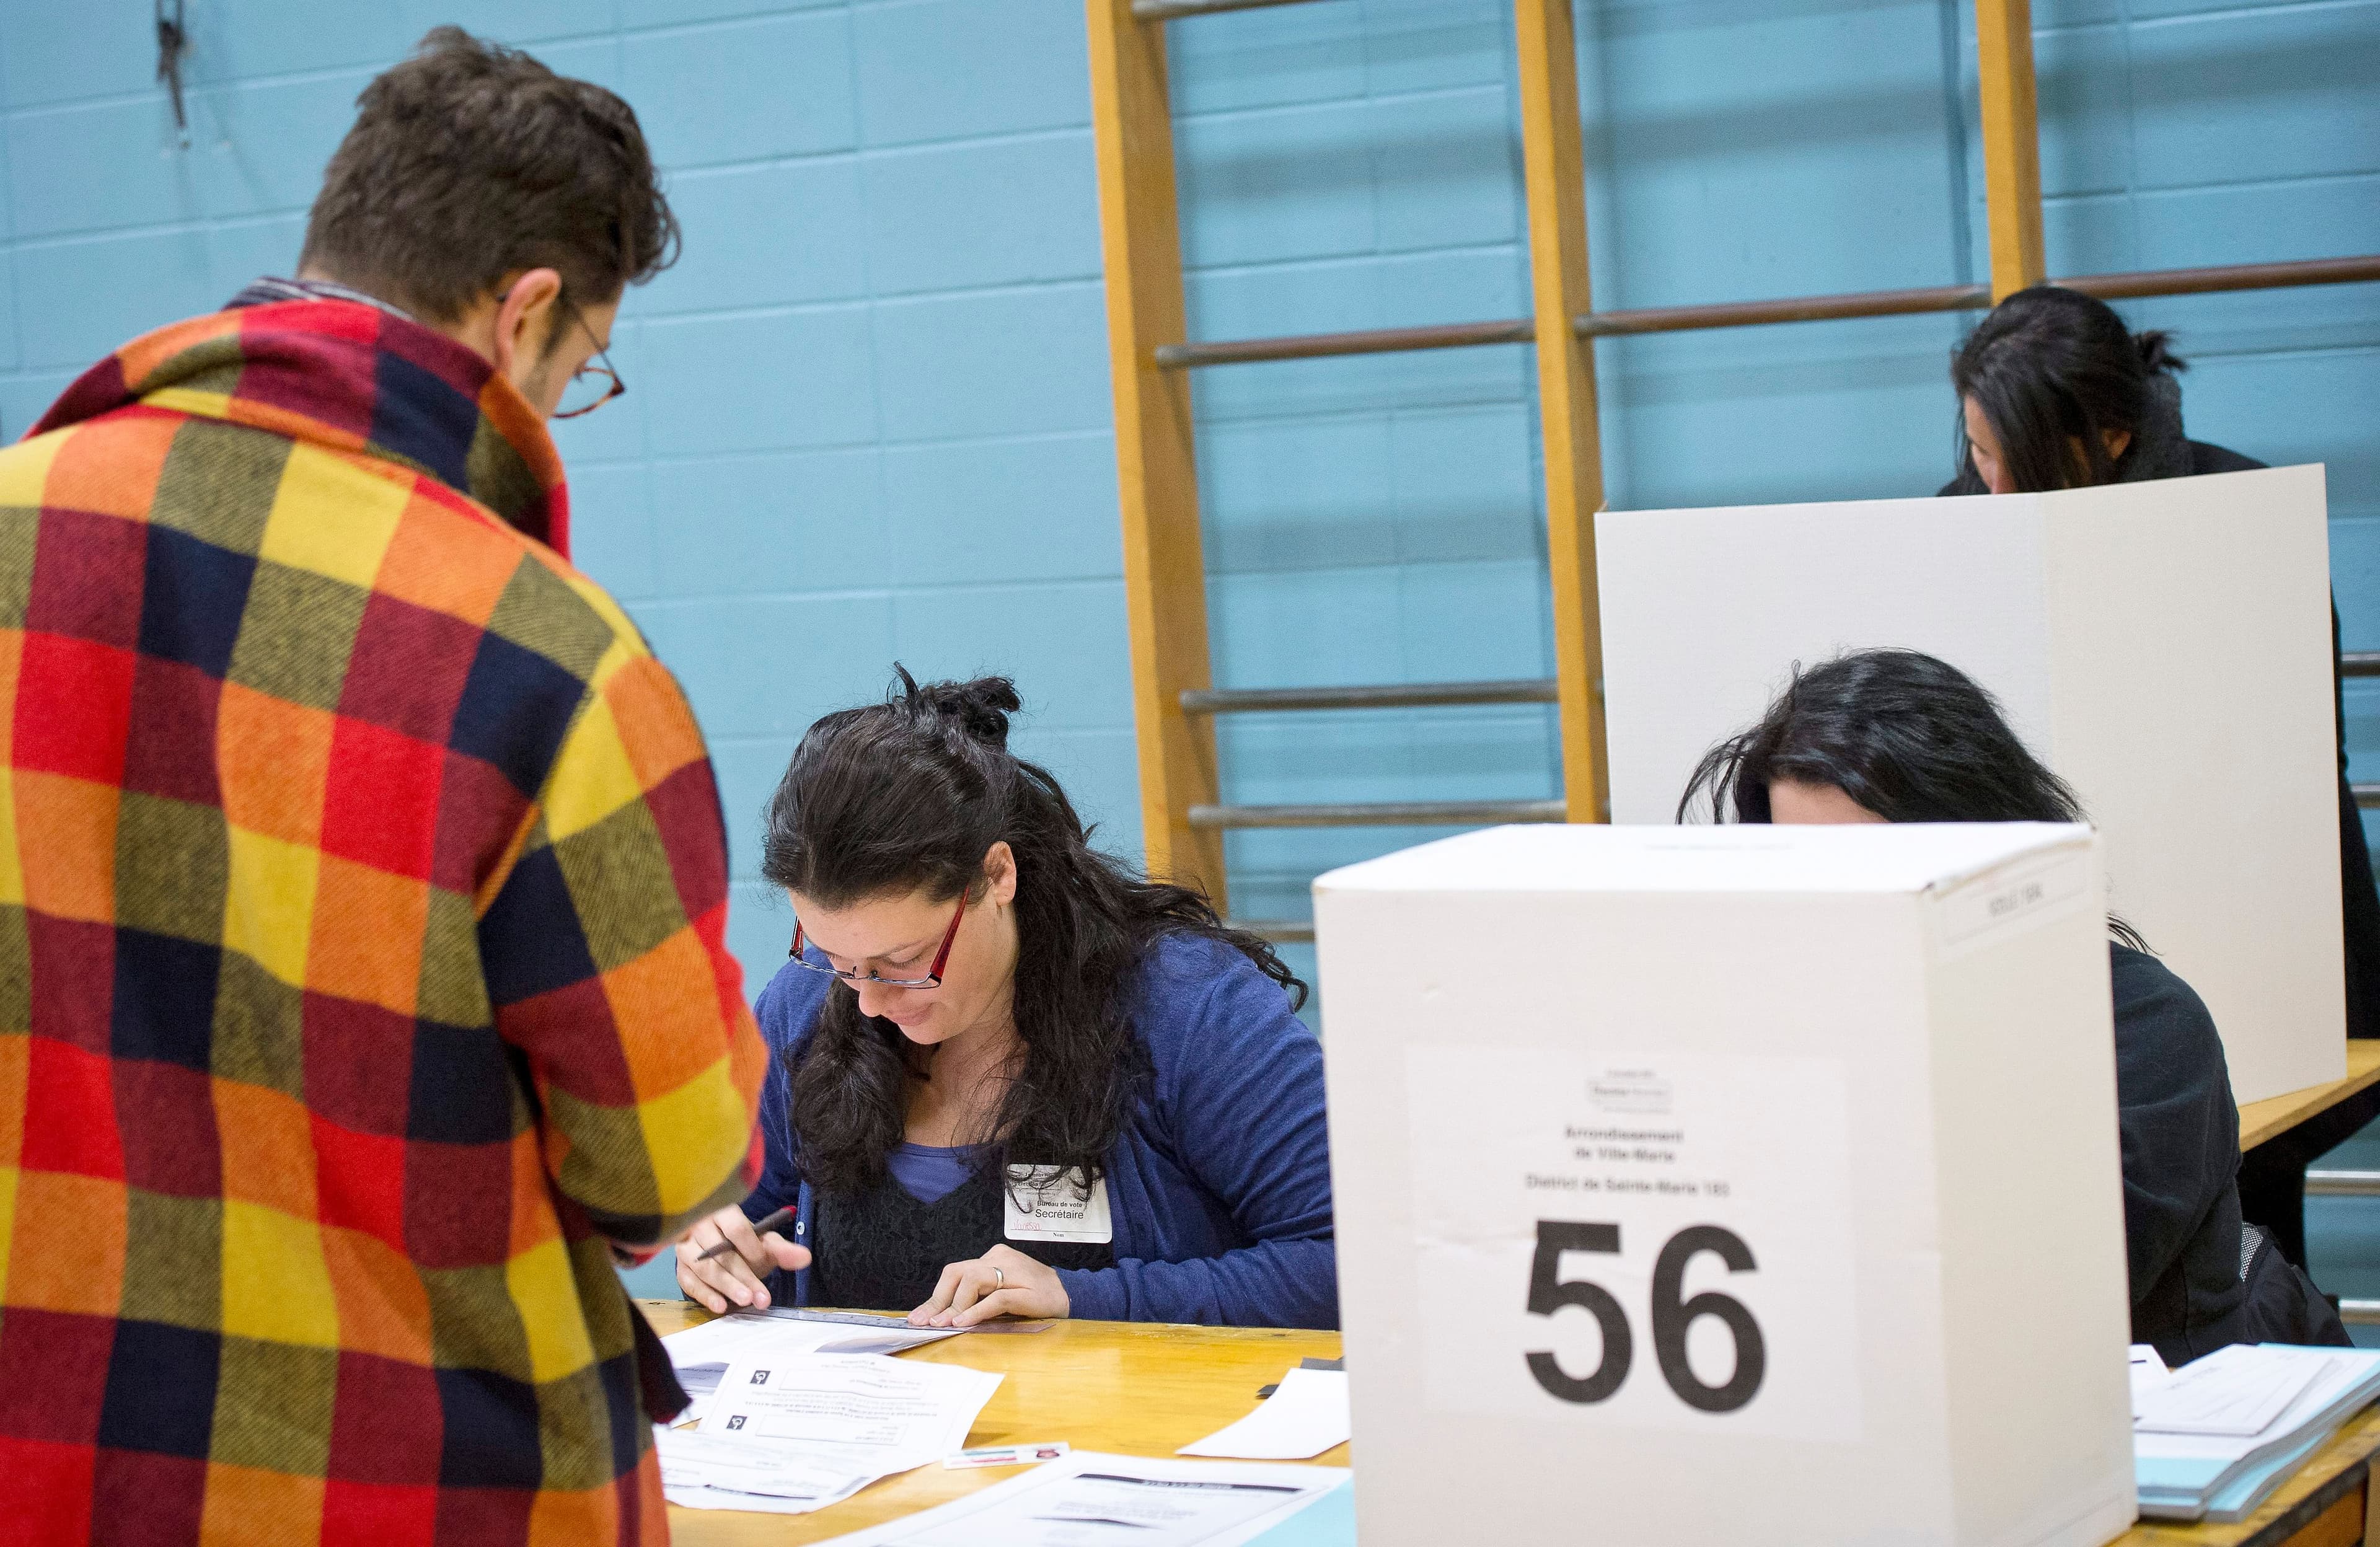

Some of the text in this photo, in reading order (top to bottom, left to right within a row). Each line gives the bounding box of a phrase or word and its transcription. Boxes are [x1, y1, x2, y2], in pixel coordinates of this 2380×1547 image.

[1564, 1124, 1684, 1143] Arrondissement
[1574, 1146, 1675, 1162] de Ville-Marie
[1525, 1173, 1577, 1190] District
[1582, 1178, 1600, 1190] de
[1603, 1177, 1699, 1196] Sainte-Marie
[1035, 1208, 1084, 1219] Secrétaire
[1524, 1219, 1768, 1414] 56
